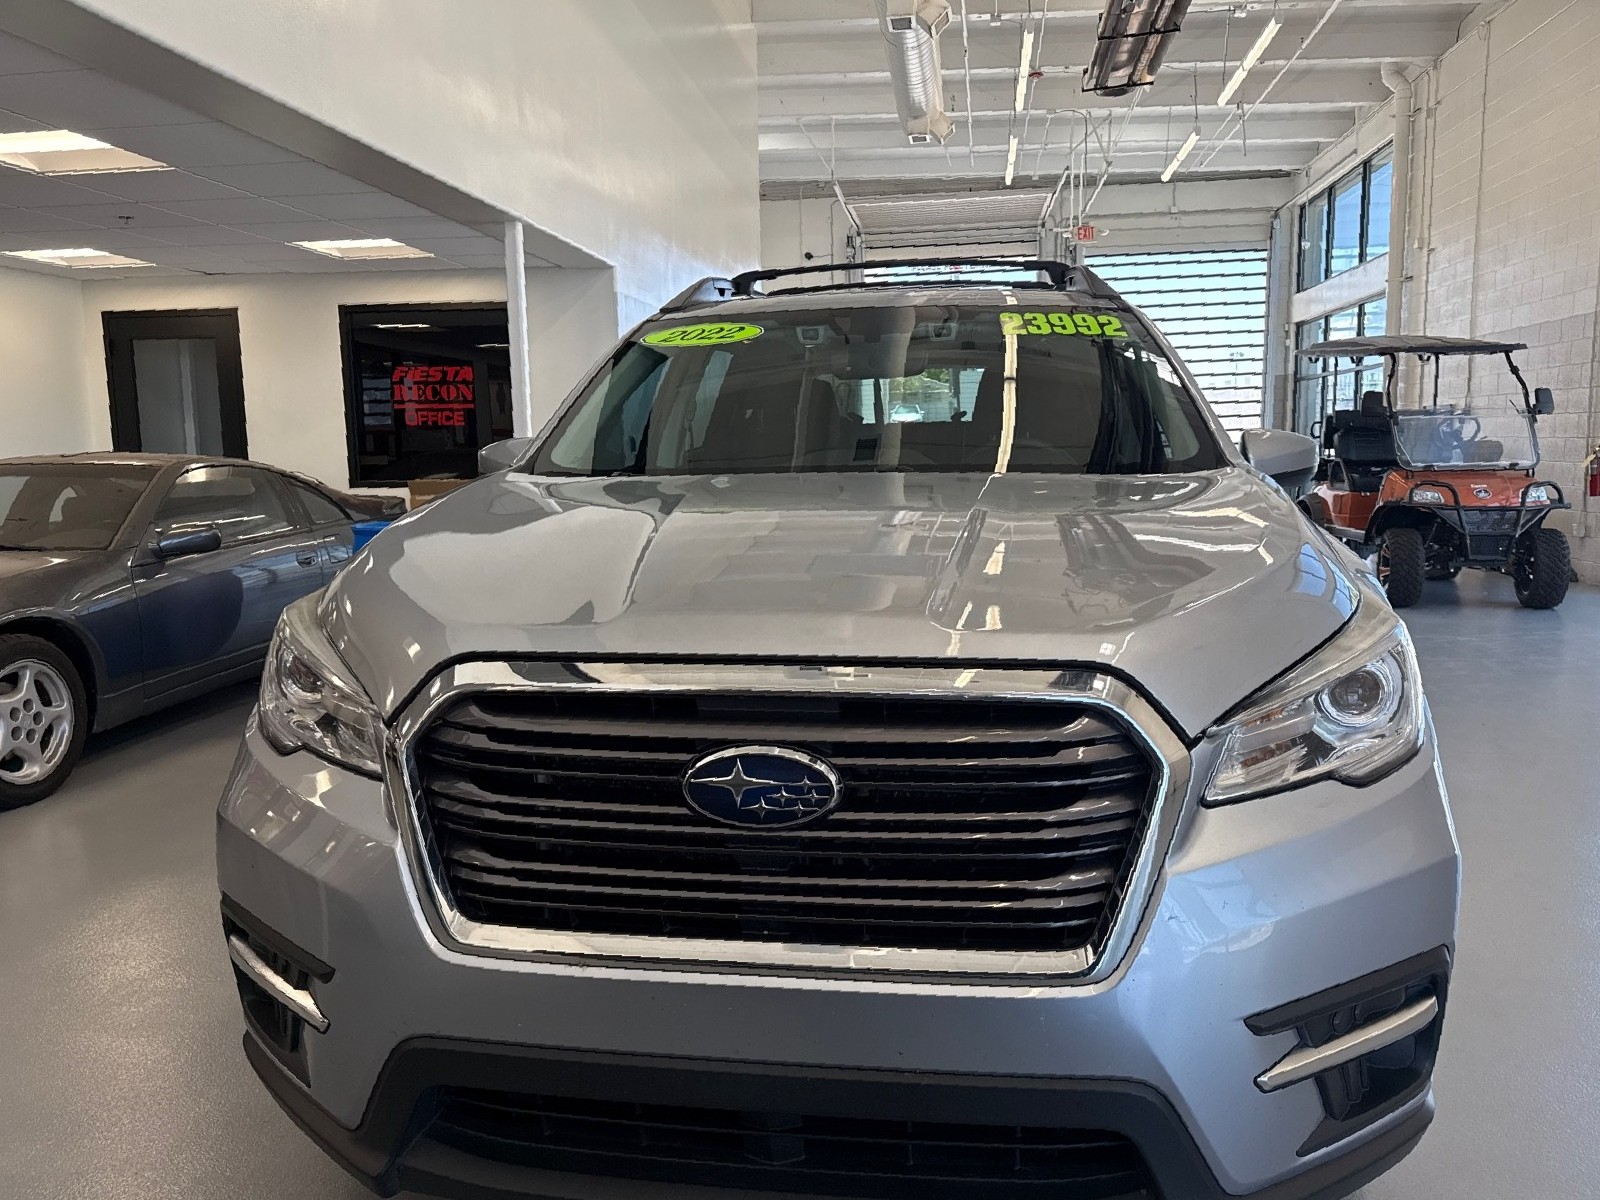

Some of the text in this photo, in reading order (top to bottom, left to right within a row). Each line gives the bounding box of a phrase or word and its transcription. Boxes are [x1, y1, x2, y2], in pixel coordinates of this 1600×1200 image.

[1077, 226, 1094, 240] EXIT
[1000, 312, 1128, 337] 23992
[657, 326, 745, 343] 2022
[392, 365, 474, 381] FIESTA
[393, 384, 474, 400] RECON
[405, 411, 465, 427] OFFICE
